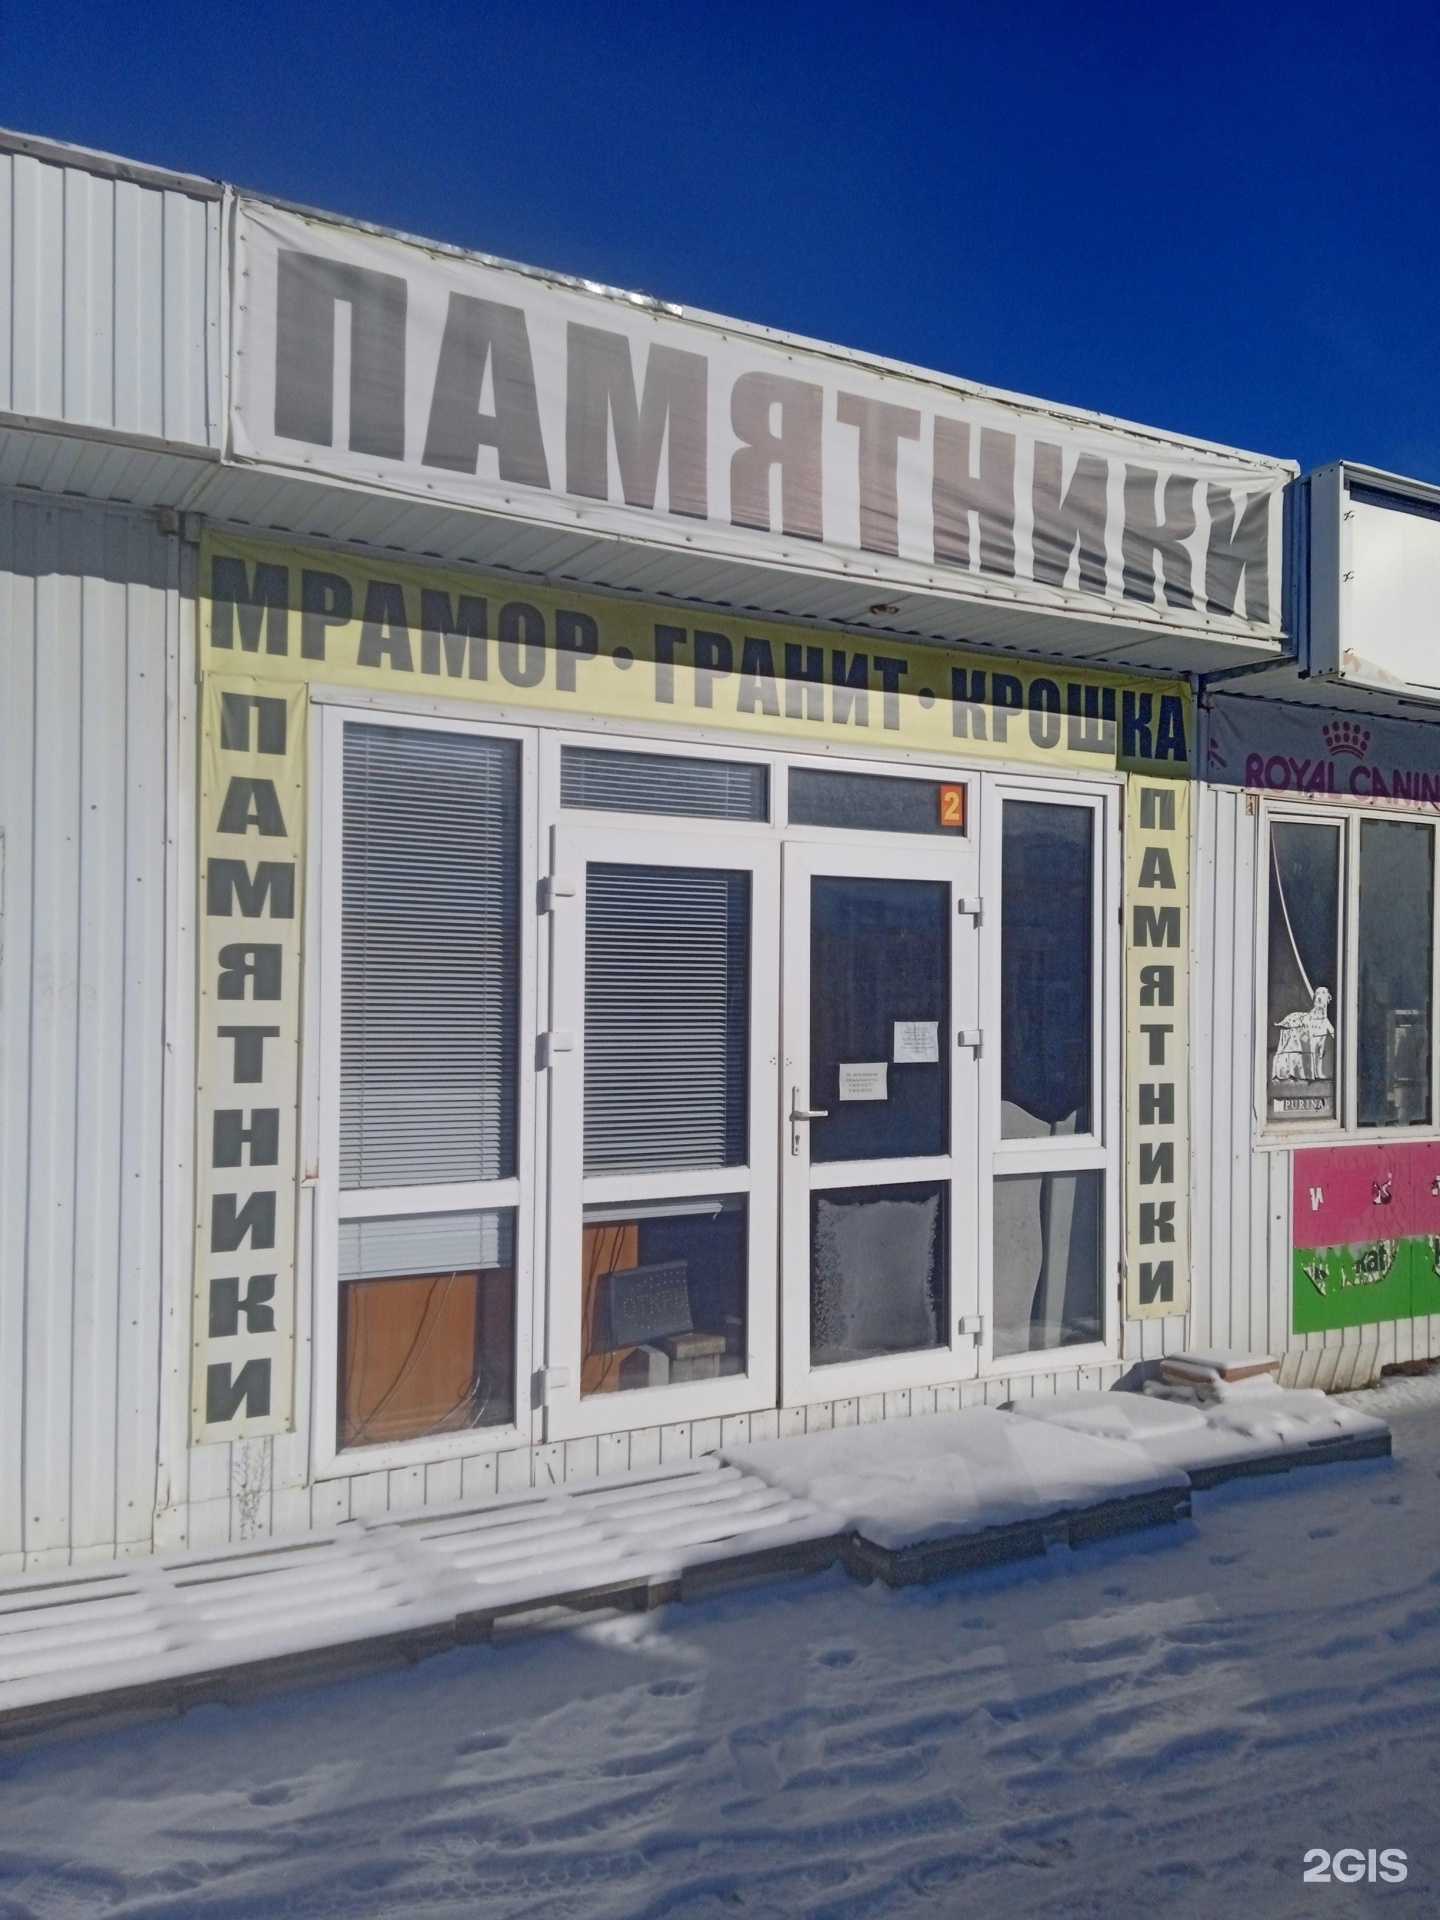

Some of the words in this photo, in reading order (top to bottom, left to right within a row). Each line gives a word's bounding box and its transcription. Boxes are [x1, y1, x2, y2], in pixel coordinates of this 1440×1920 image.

[274, 248, 1271, 625] ПАМЯТНИКИ
[209, 554, 600, 693] МРАМОР
[653, 623, 908, 731] ГРАНИТ
[951, 666, 1189, 763] КРОШКА
[1245, 752, 1342, 799] ROYAL
[943, 791, 960, 820] 2
[204, 691, 296, 1424] ПАМЯТНИКИ
[1133, 787, 1181, 1304] ПАМЯТНИКИ
